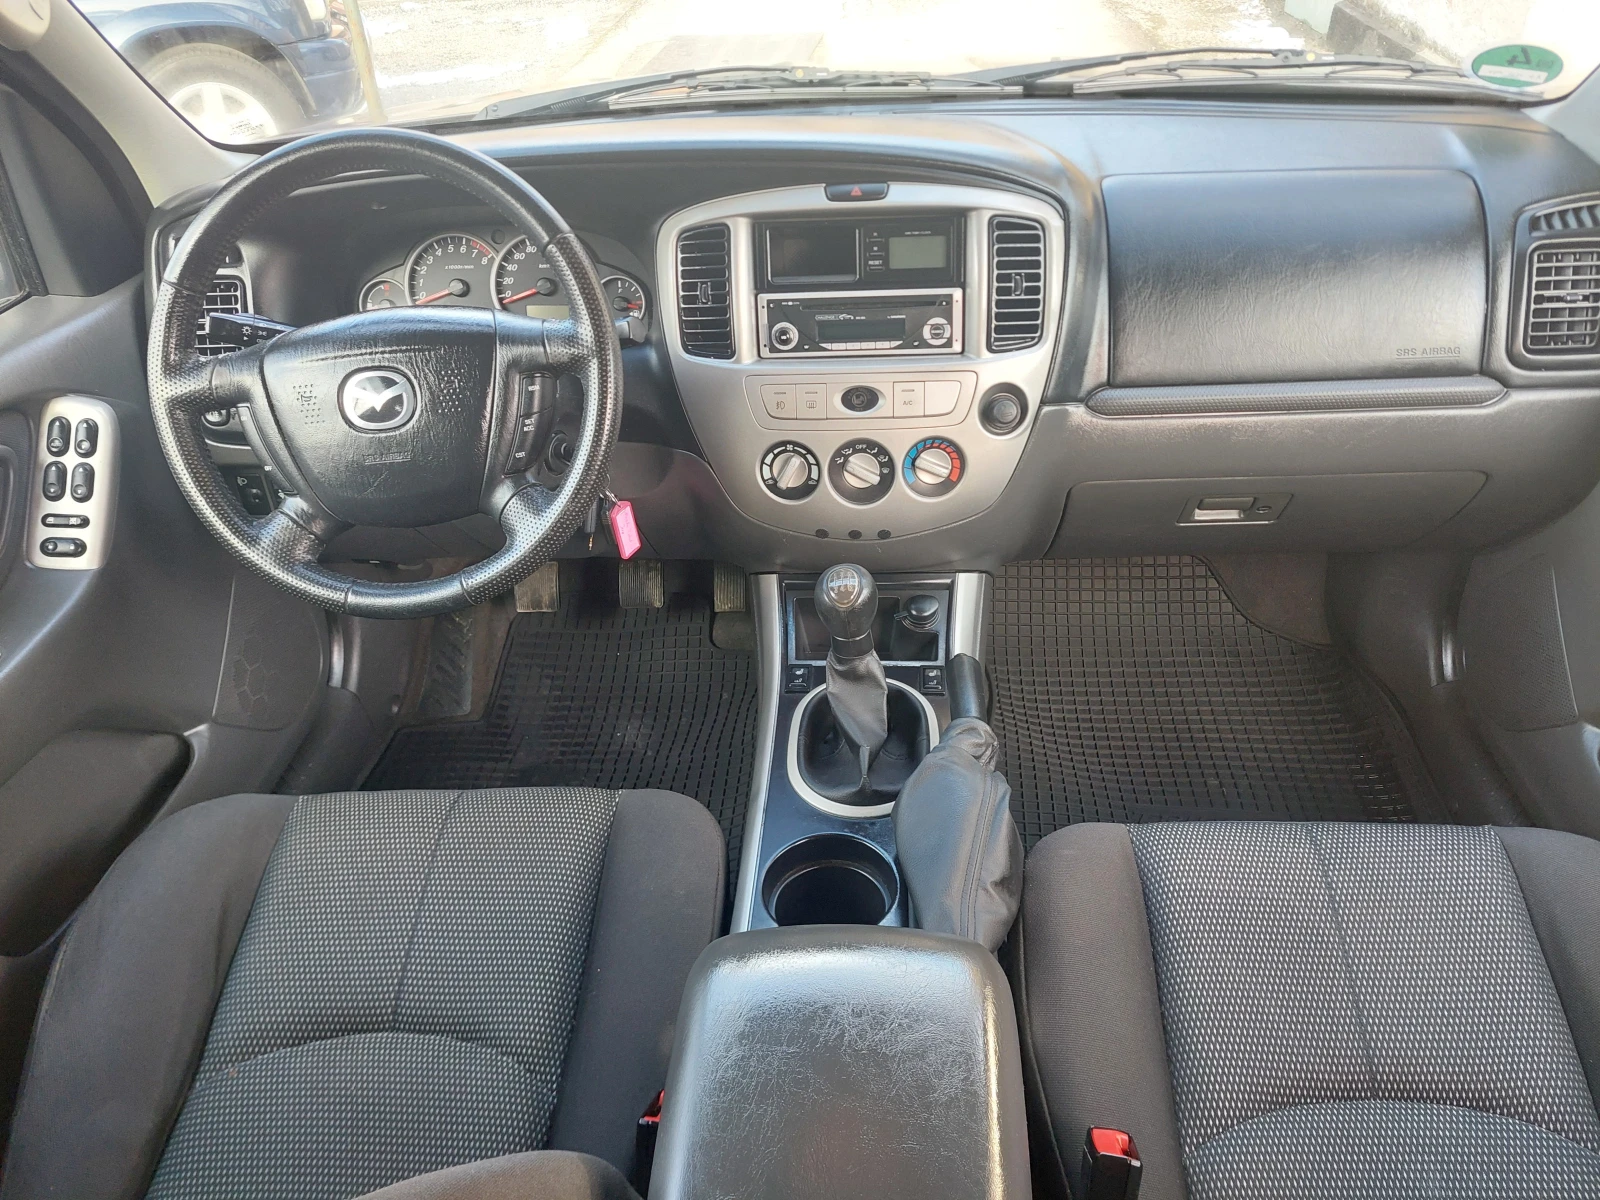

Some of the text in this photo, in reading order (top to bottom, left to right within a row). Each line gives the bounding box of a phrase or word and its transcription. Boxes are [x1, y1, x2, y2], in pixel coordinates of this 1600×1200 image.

[435, 248, 442, 256] 4
[447, 244, 455, 253] 5
[460, 245, 467, 253] 6
[471, 249, 478, 258] 7
[513, 252, 525, 260] 60
[426, 255, 434, 264] 3
[481, 256, 488, 265] 8
[420, 265, 427, 274] 2
[506, 263, 518, 271] 40
[419, 278, 424, 287] 1
[502, 277, 514, 285] 20
[419, 291, 426, 300] 0
[505, 290, 512, 298] 0
[1395, 346, 1461, 357] SRS AIRBAG
